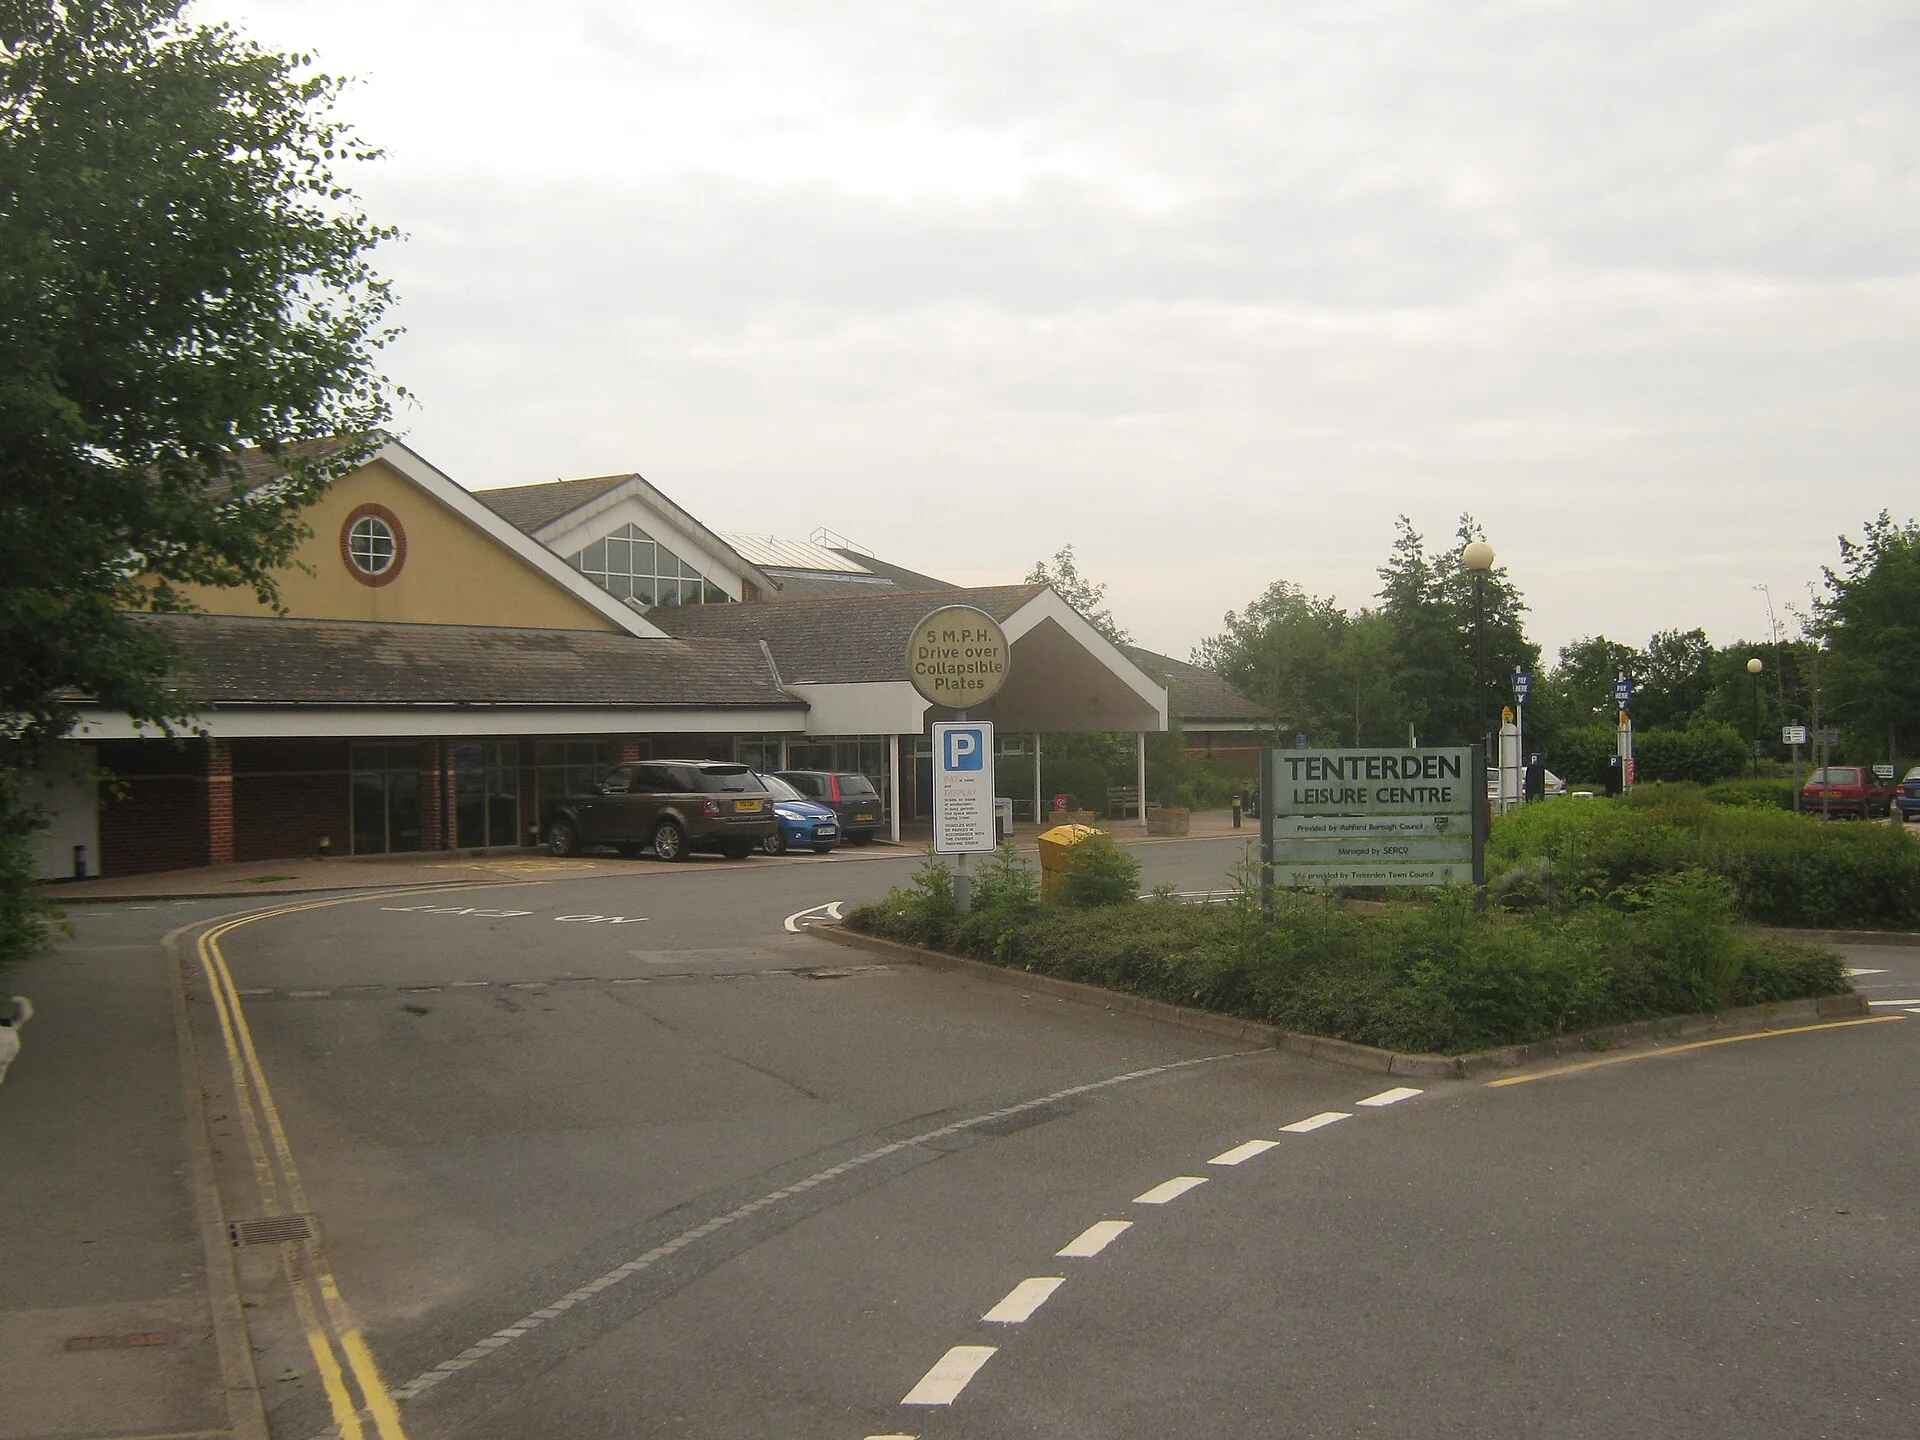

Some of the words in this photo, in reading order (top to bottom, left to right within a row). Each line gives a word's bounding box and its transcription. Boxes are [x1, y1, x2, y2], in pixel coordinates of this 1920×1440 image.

[926, 630, 937, 644] 5
[942, 629, 992, 643] M.P.H.
[918, 646, 960, 660] Drive
[965, 647, 999, 658] over
[915, 661, 1003, 676] Collapsible
[934, 678, 985, 691] Plates
[1517, 676, 1527, 684] PAY
[951, 733, 976, 768] P
[1531, 755, 1537, 764] P
[1610, 757, 1617, 766] P
[1284, 755, 1461, 781] TENTERDEN
[944, 789, 976, 797] DISPLAY
[1293, 788, 1368, 805] LEISURE
[1375, 786, 1452, 804] CENTRE
[1297, 824, 1326, 832] Provided
[1328, 824, 1337, 832] by
[1340, 823, 1367, 831] Ashford
[1369, 823, 1397, 832] Borough
[1399, 822, 1424, 830] Council
[1338, 847, 1370, 856] Managed
[1371, 847, 1380, 855] by
[1339, 871, 1348, 880] by
[1351, 871, 1386, 879] Tenterden
[1388, 870, 1408, 878] Town
[1408, 870, 1434, 878] Council
